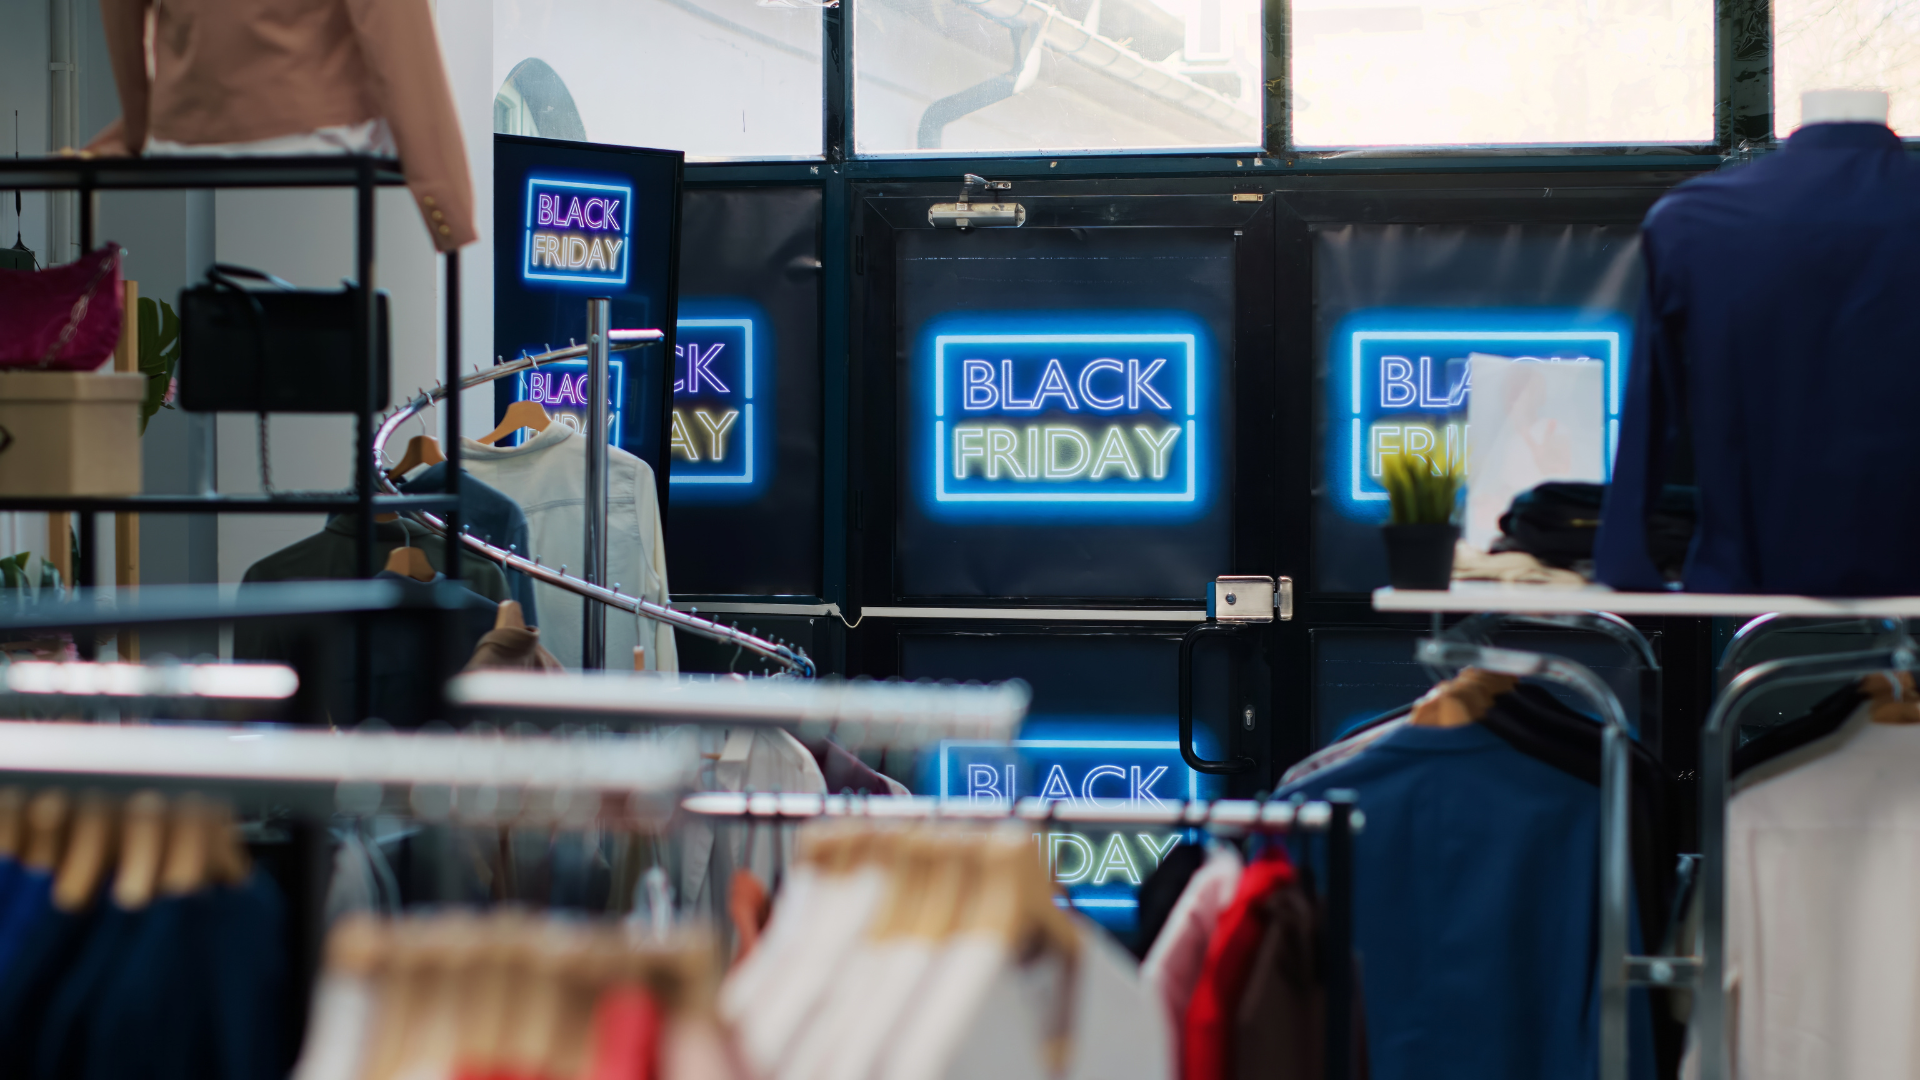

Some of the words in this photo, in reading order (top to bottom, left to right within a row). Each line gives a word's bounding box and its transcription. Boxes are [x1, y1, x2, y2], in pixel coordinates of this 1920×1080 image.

[537, 194, 620, 230] BLACK
[531, 234, 623, 270] FRIDAY
[529, 373, 612, 404] BLAC
[963, 358, 1172, 410] BLACK
[955, 427, 1182, 479] FRIDAY
[1371, 424, 1471, 477] FRI
